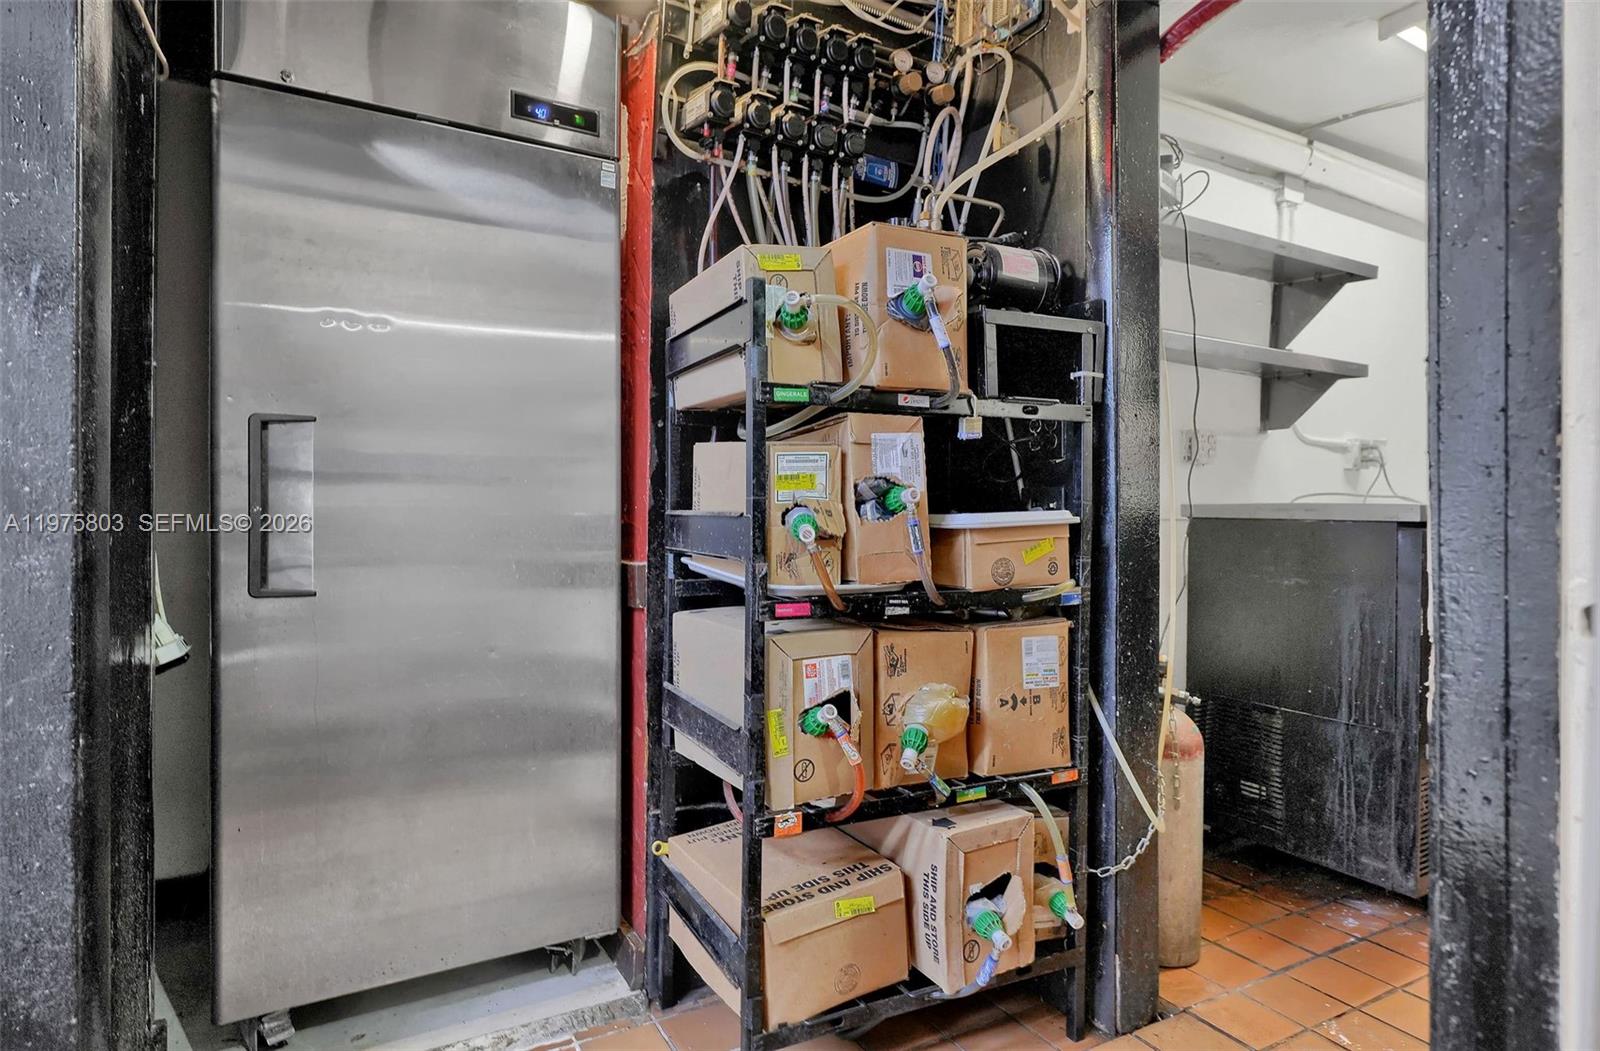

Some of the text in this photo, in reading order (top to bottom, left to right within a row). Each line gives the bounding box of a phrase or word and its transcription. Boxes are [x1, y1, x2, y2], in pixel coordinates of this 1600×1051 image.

[767, 862, 870, 901] THIS SIDE UP
[818, 878, 852, 894] AND
[856, 863, 893, 882] SHIP
[762, 891, 815, 914] STORE
[922, 872, 932, 950] THIS SIDE UP
[929, 863, 940, 965] SHIP AND STORE
